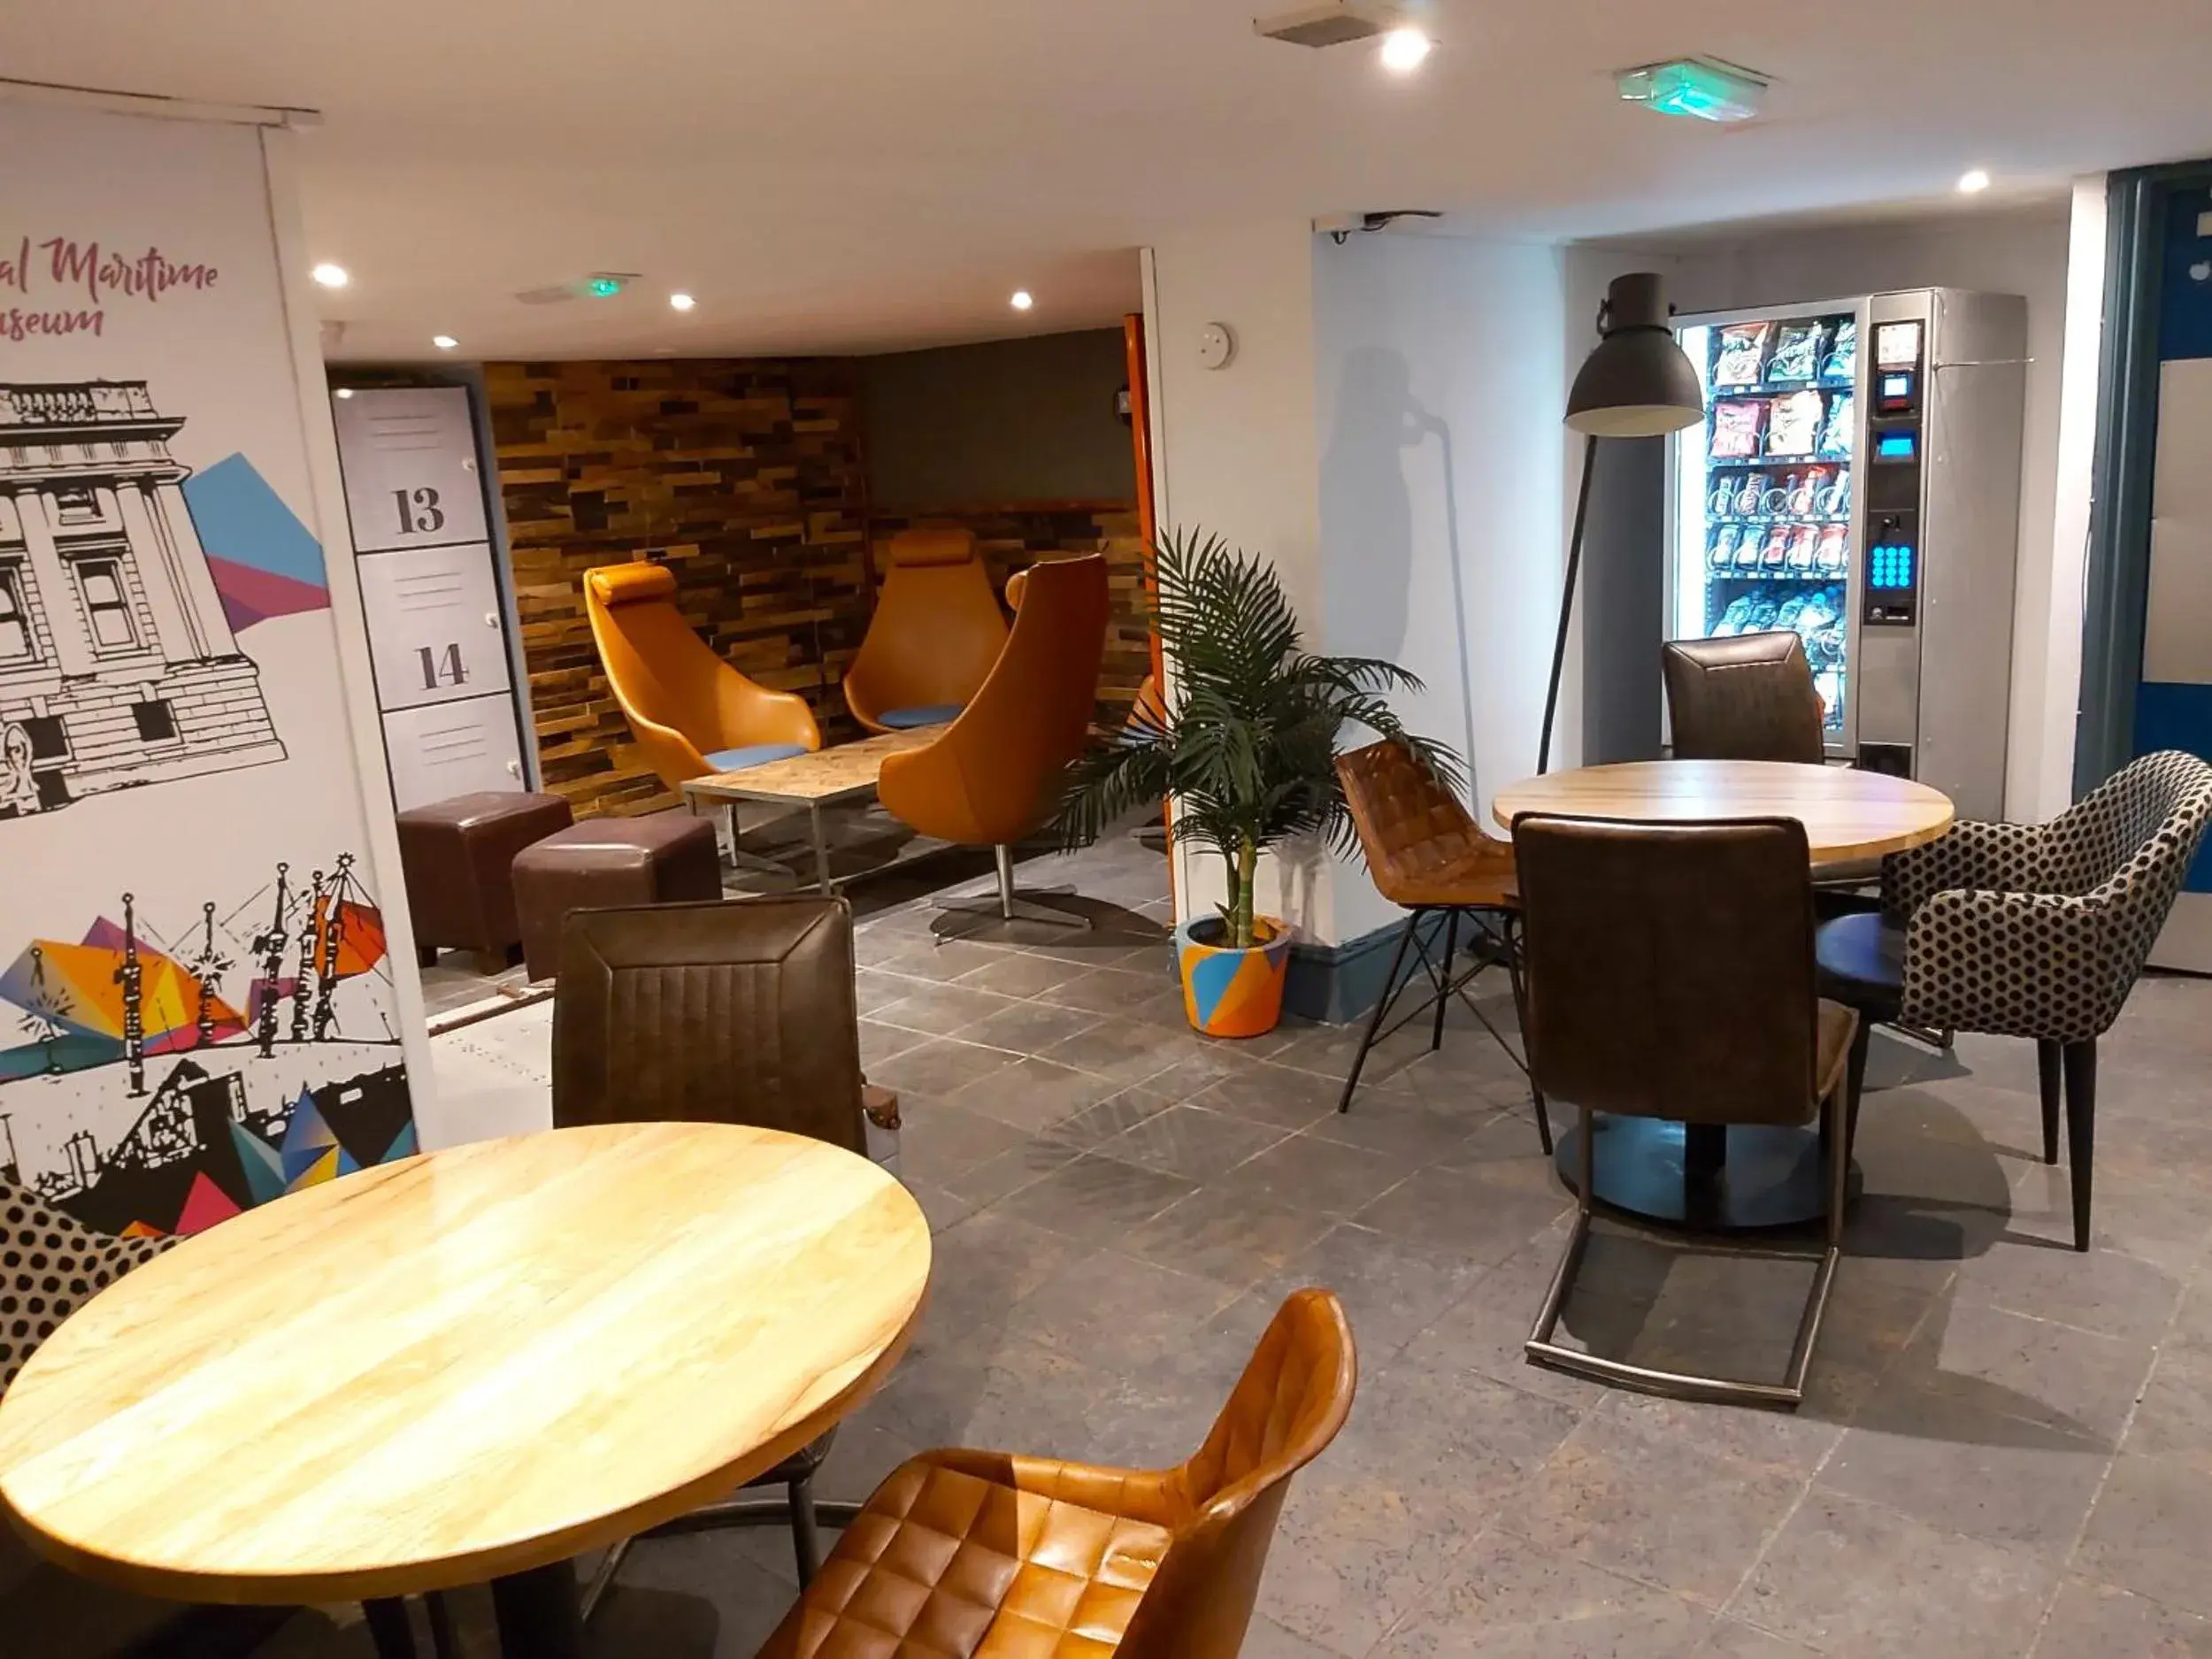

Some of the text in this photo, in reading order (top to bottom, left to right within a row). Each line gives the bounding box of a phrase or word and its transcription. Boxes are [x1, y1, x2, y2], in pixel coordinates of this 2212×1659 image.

[39, 236, 219, 304] Maritime
[390, 487, 444, 534] 13
[413, 643, 471, 691] 14
